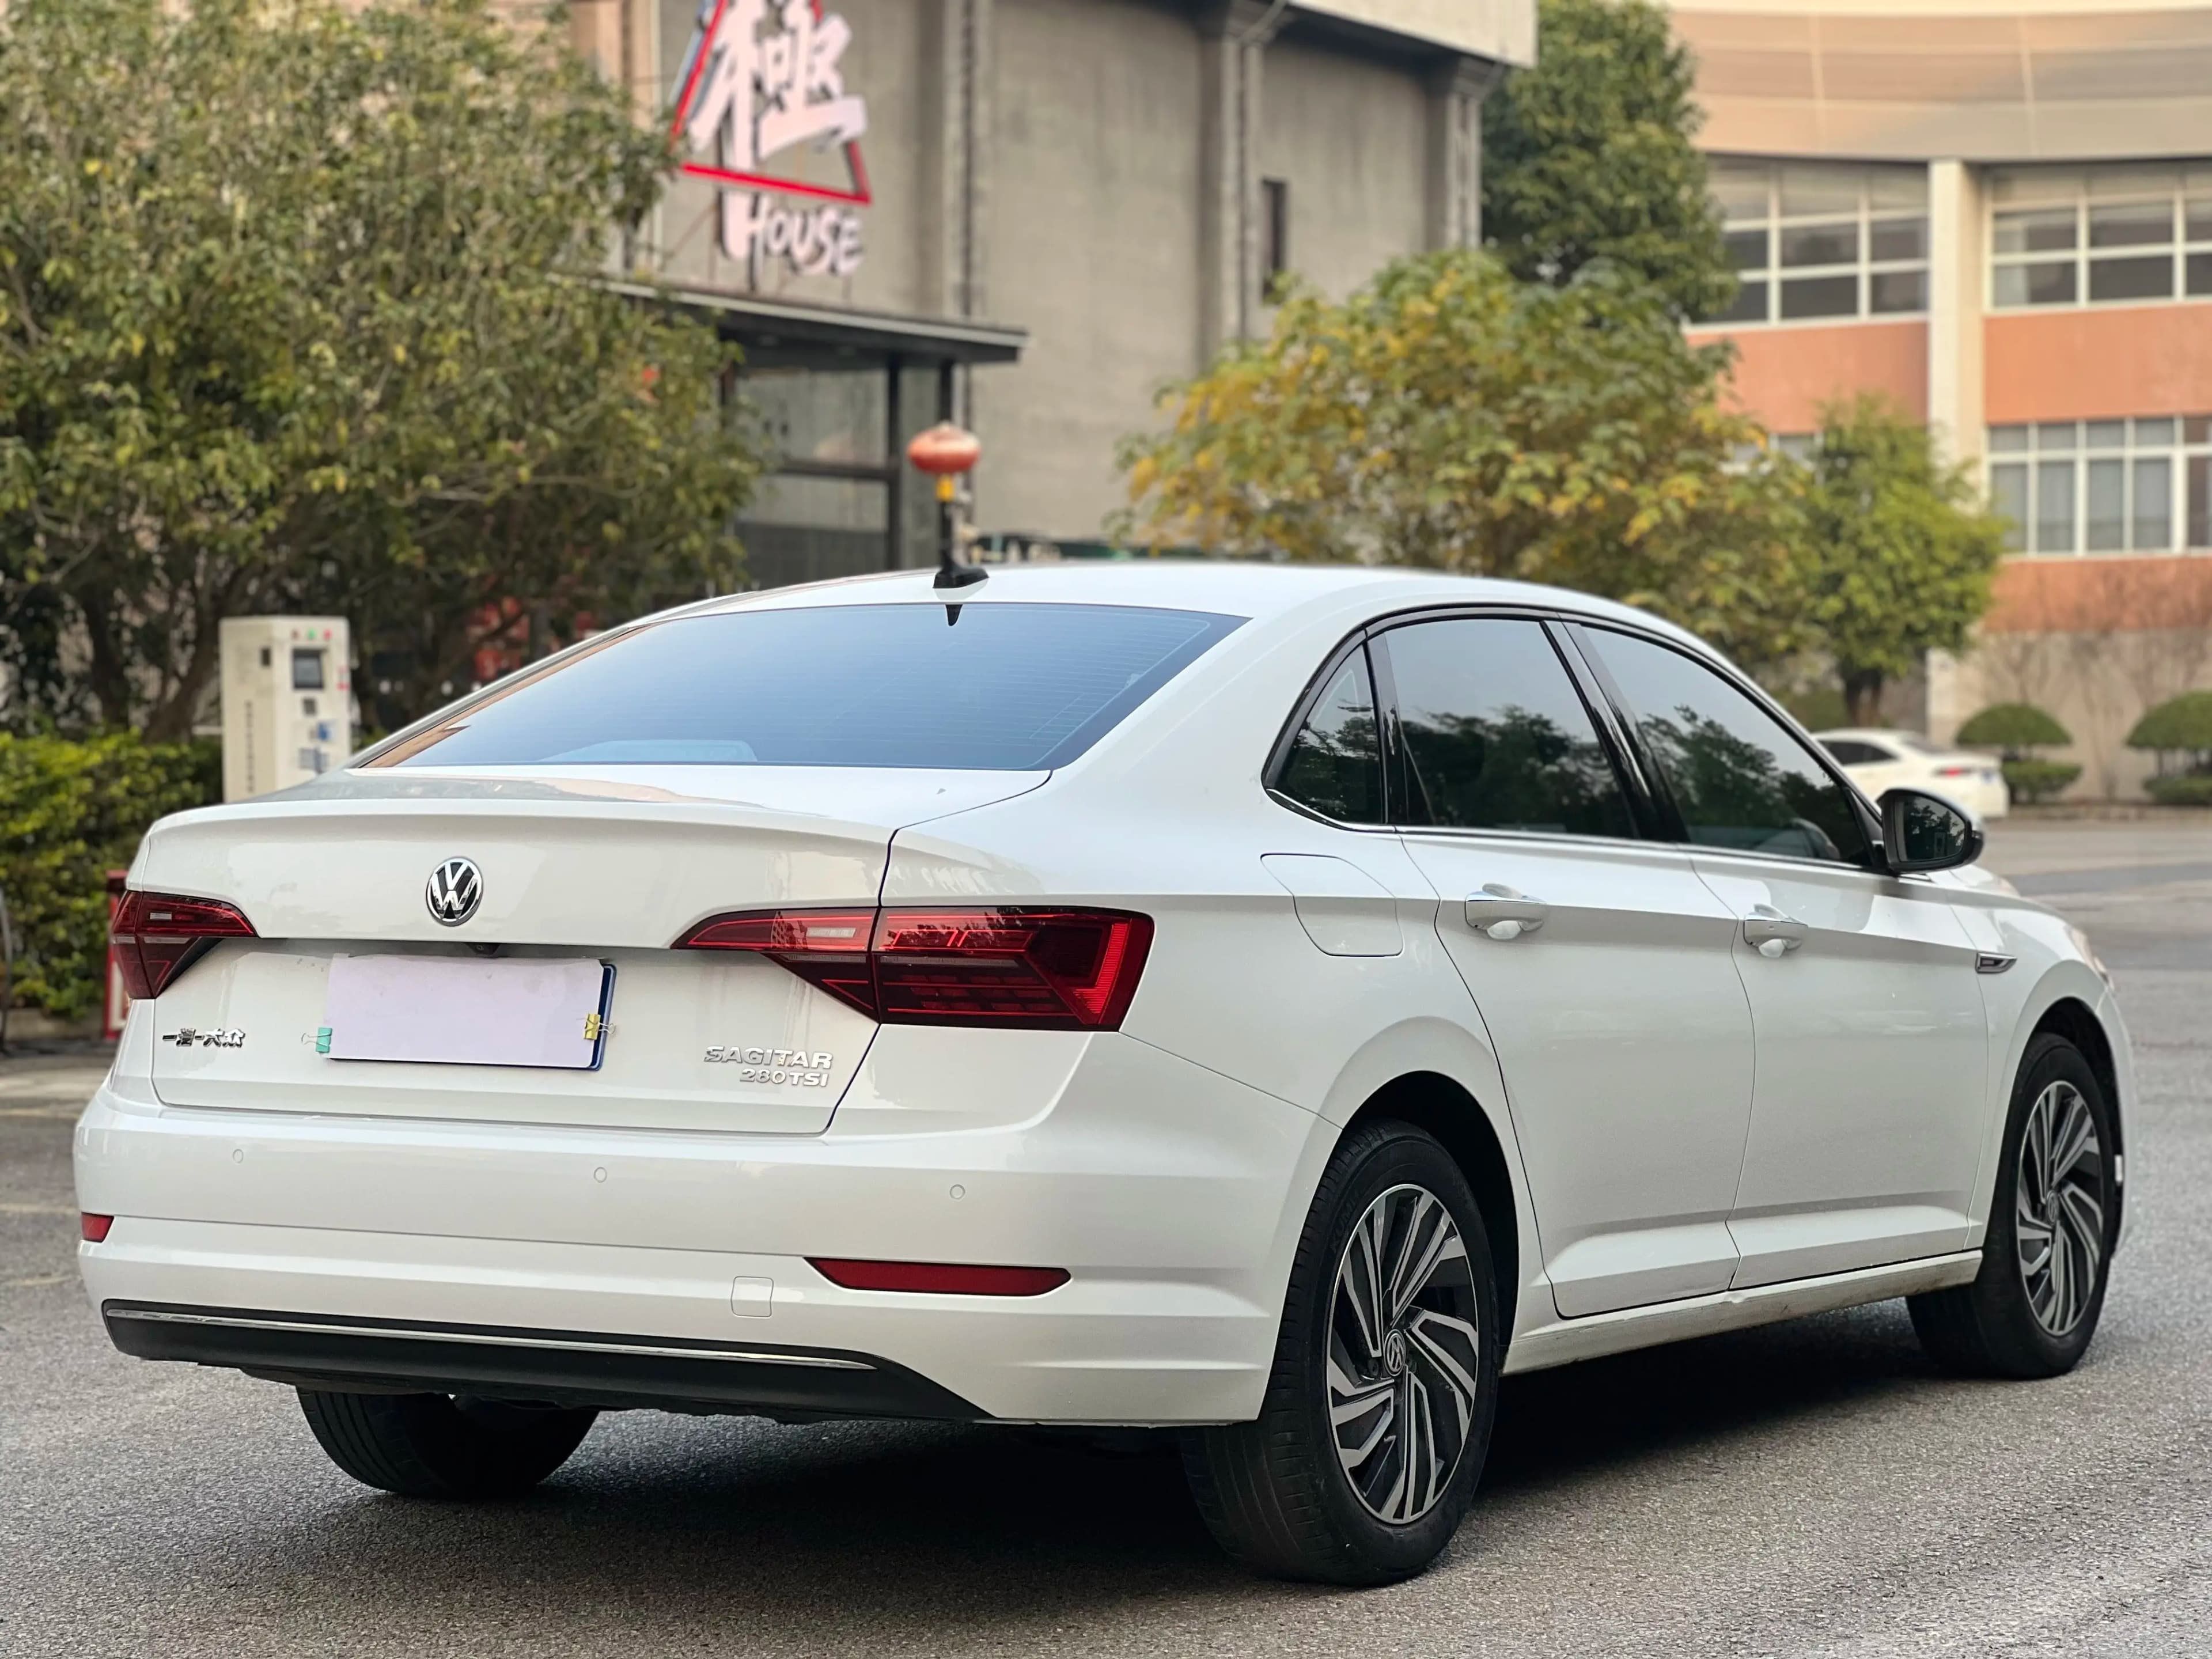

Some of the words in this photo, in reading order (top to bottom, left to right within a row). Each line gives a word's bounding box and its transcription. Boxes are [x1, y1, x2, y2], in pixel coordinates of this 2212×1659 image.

[722, 187, 864, 278] HOUSE
[427, 857, 483, 926] VW
[704, 1046, 833, 1069] SAGITAR
